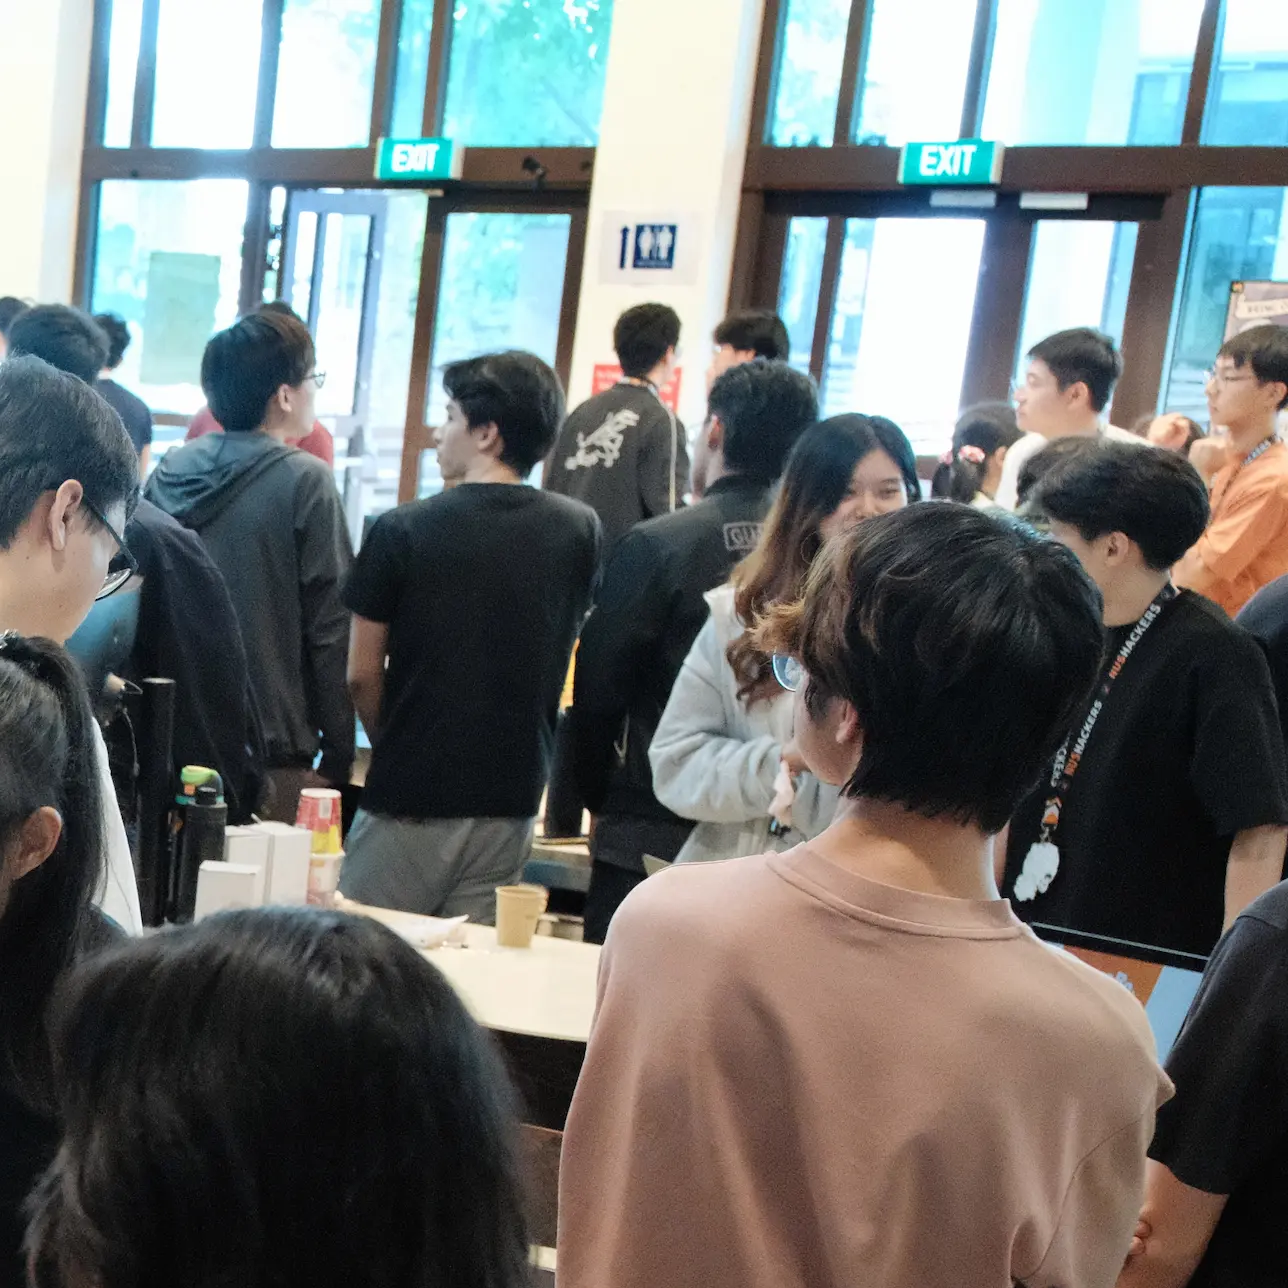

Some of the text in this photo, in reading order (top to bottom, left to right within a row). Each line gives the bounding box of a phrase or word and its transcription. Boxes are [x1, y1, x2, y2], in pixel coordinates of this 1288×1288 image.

[391, 143, 440, 172] EXIT
[919, 144, 978, 176] EXIT
[1108, 602, 1162, 680] NUSHACKERS
[1063, 698, 1103, 777] NUSHACKERS
